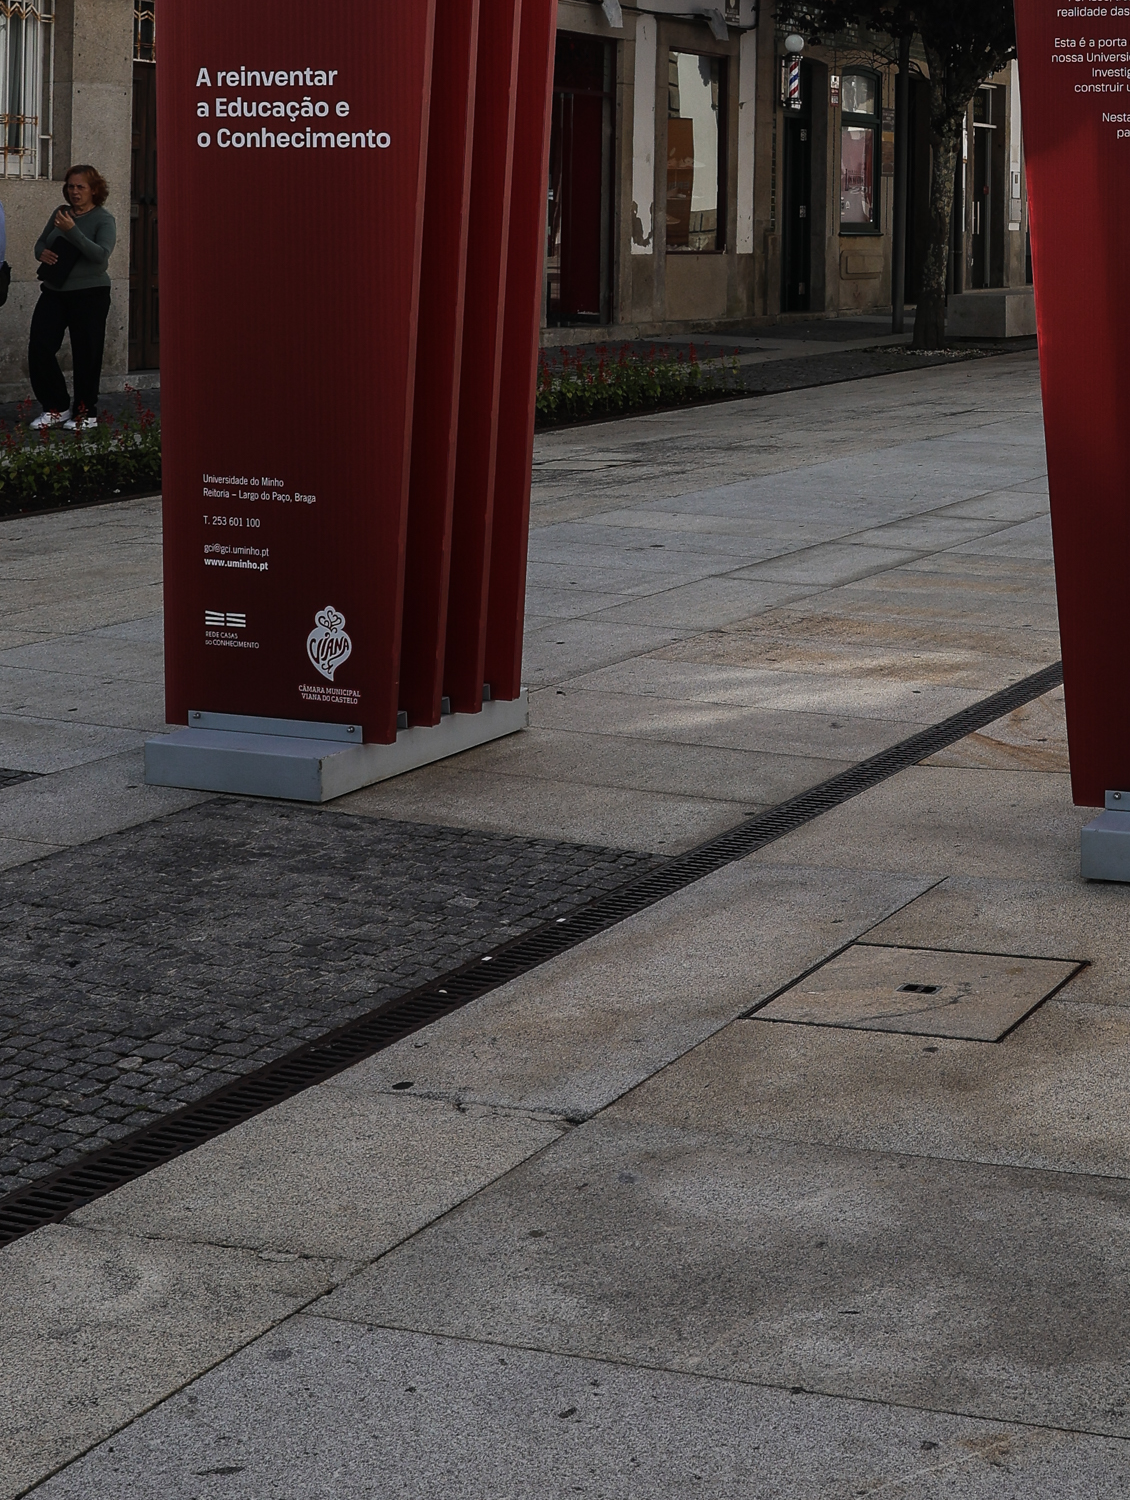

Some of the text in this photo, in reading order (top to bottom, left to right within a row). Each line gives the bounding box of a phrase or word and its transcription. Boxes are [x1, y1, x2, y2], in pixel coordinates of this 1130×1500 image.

[1057, 6, 1108, 17] realidade
[1110, 6, 1130, 17] das
[195, 65, 338, 87] A reinventar
[1074, 82, 1125, 93] construir
[196, 96, 350, 122] a Educação e
[197, 127, 391, 148] o Conhecimento
[203, 474, 284, 487] Universidade do Minho
[203, 487, 230, 498] Reitoria
[238, 489, 260, 502] Largo
[260, 491, 271, 501] do
[272, 491, 293, 503] Paço,
[294, 492, 316, 505] Braga
[202, 515, 261, 528] T. 253 601 100
[203, 543, 270, 558] gci@gci.uminho.pt
[203, 558, 269, 572] www.uminho.pt
[220, 631, 239, 639] CASAS
[212, 639, 260, 649] CONHECIMENTO
[309, 632, 350, 664] VIANA
[298, 684, 361, 697] CÂMARA MUNICIPAL
[301, 693, 322, 701] VIANA
[331, 696, 358, 705] CASTELO
